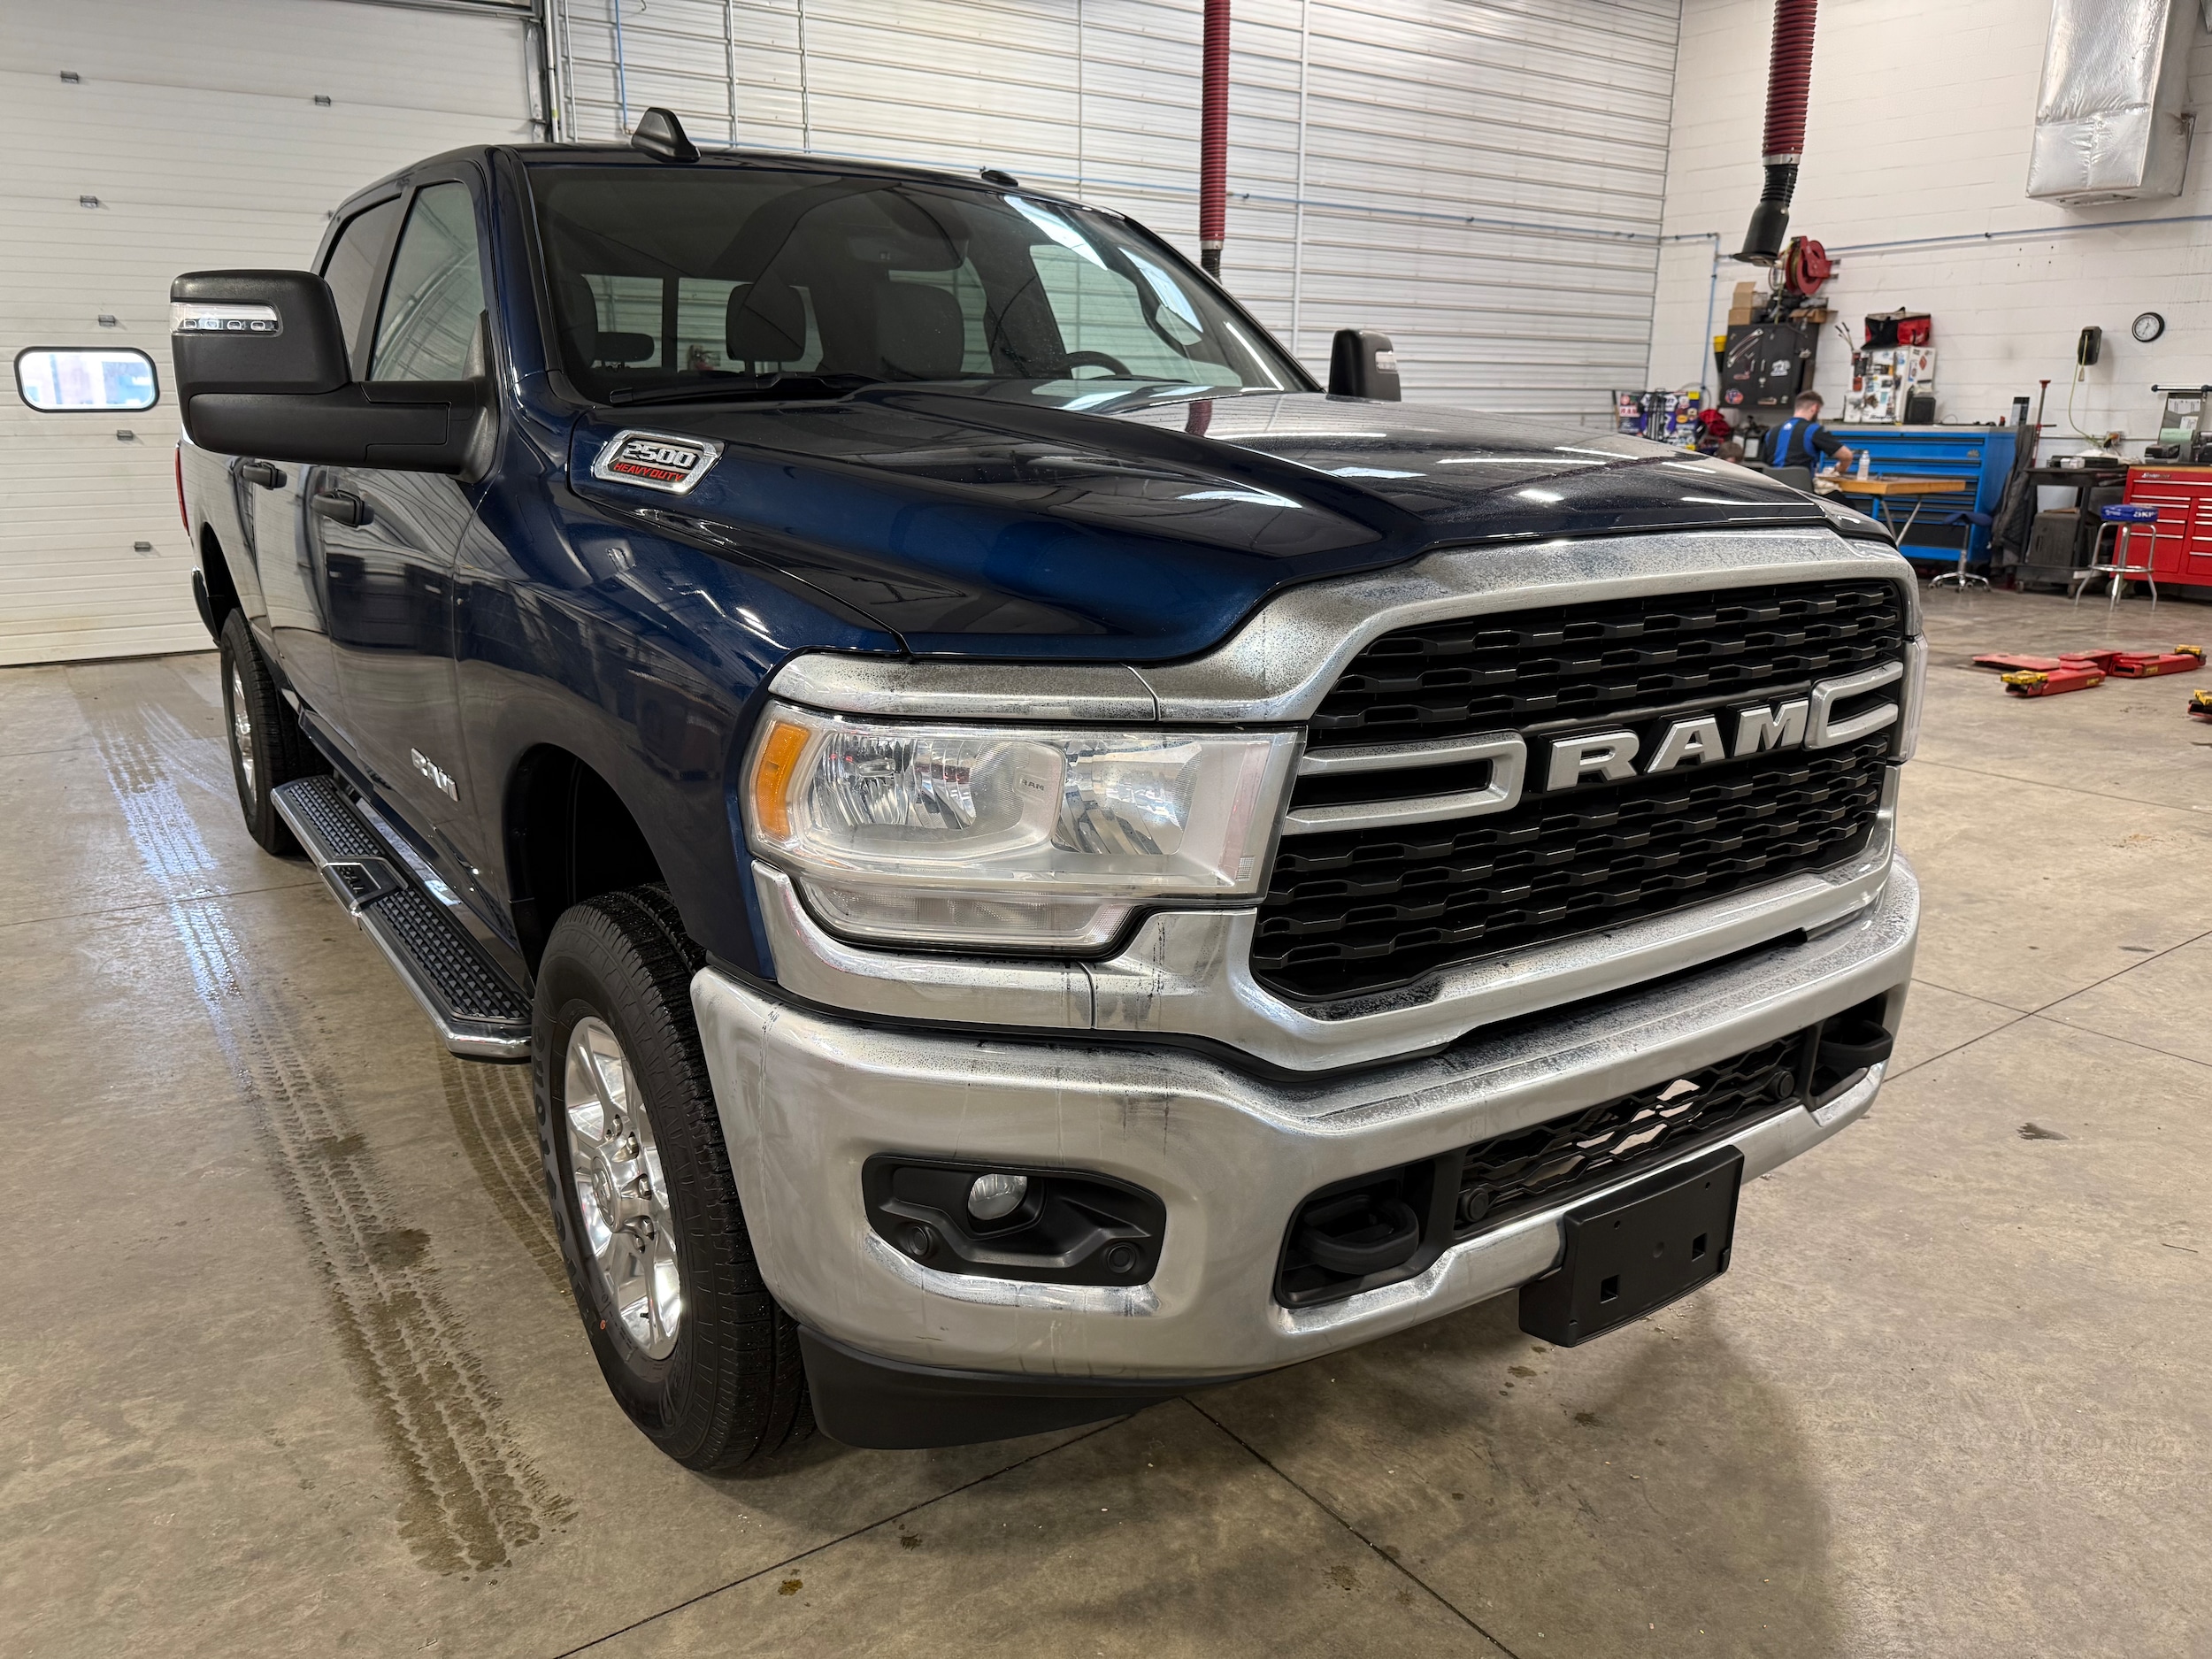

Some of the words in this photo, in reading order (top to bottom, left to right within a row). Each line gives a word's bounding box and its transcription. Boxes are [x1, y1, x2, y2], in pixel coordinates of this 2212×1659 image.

[622, 442, 696, 469] 2500
[1546, 697, 1809, 792] RAM
[411, 748, 459, 803] RAM
[1019, 778, 1045, 791] RAM
